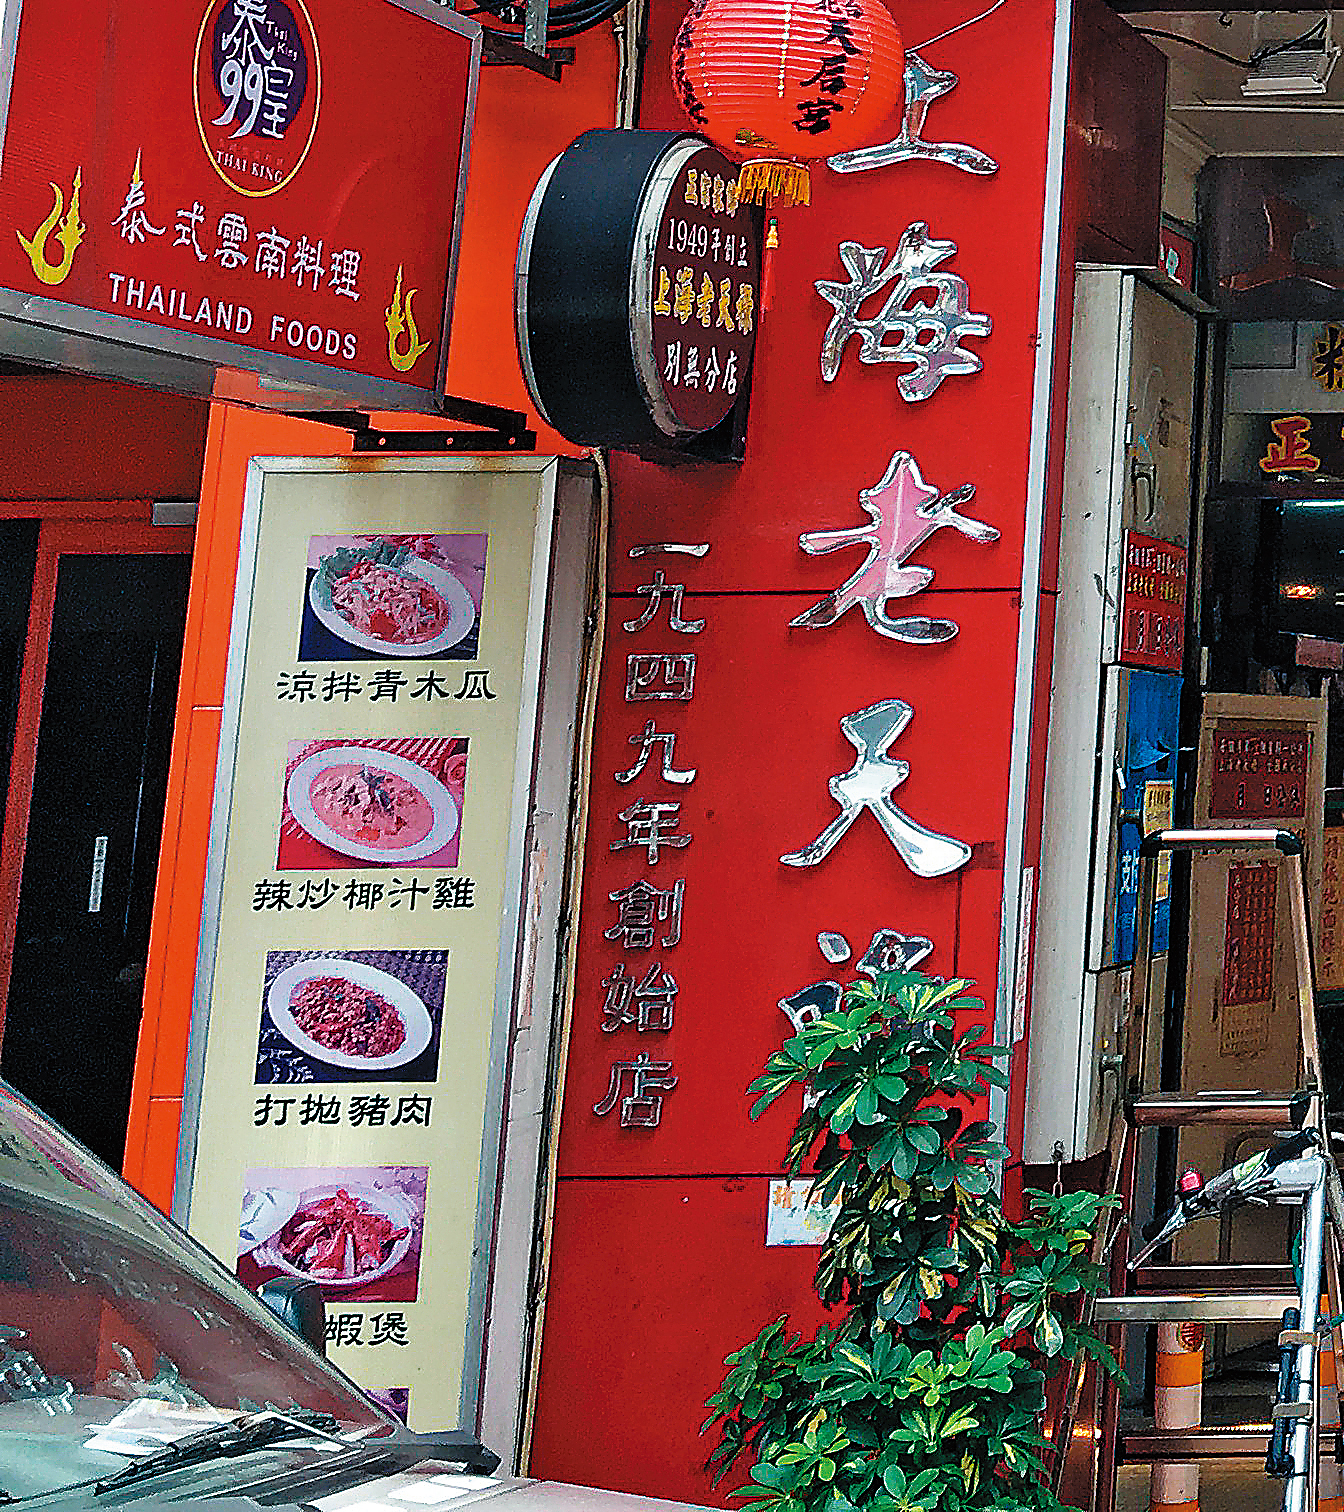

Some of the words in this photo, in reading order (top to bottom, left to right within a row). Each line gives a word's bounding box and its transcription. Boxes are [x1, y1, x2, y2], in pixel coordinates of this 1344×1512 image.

[792, 19, 862, 134] 天后宮
[215, 150, 248, 173] THAI
[251, 160, 284, 184] KING
[110, 179, 363, 302] 泰式雲南料理
[108, 273, 253, 335] THAILAND
[270, 315, 358, 361] FOODS
[275, 668, 498, 703] 涼拌青木瓜
[592, 540, 711, 1130] 一九四九年創始店
[250, 876, 477, 913] 辣炒椰汁雞
